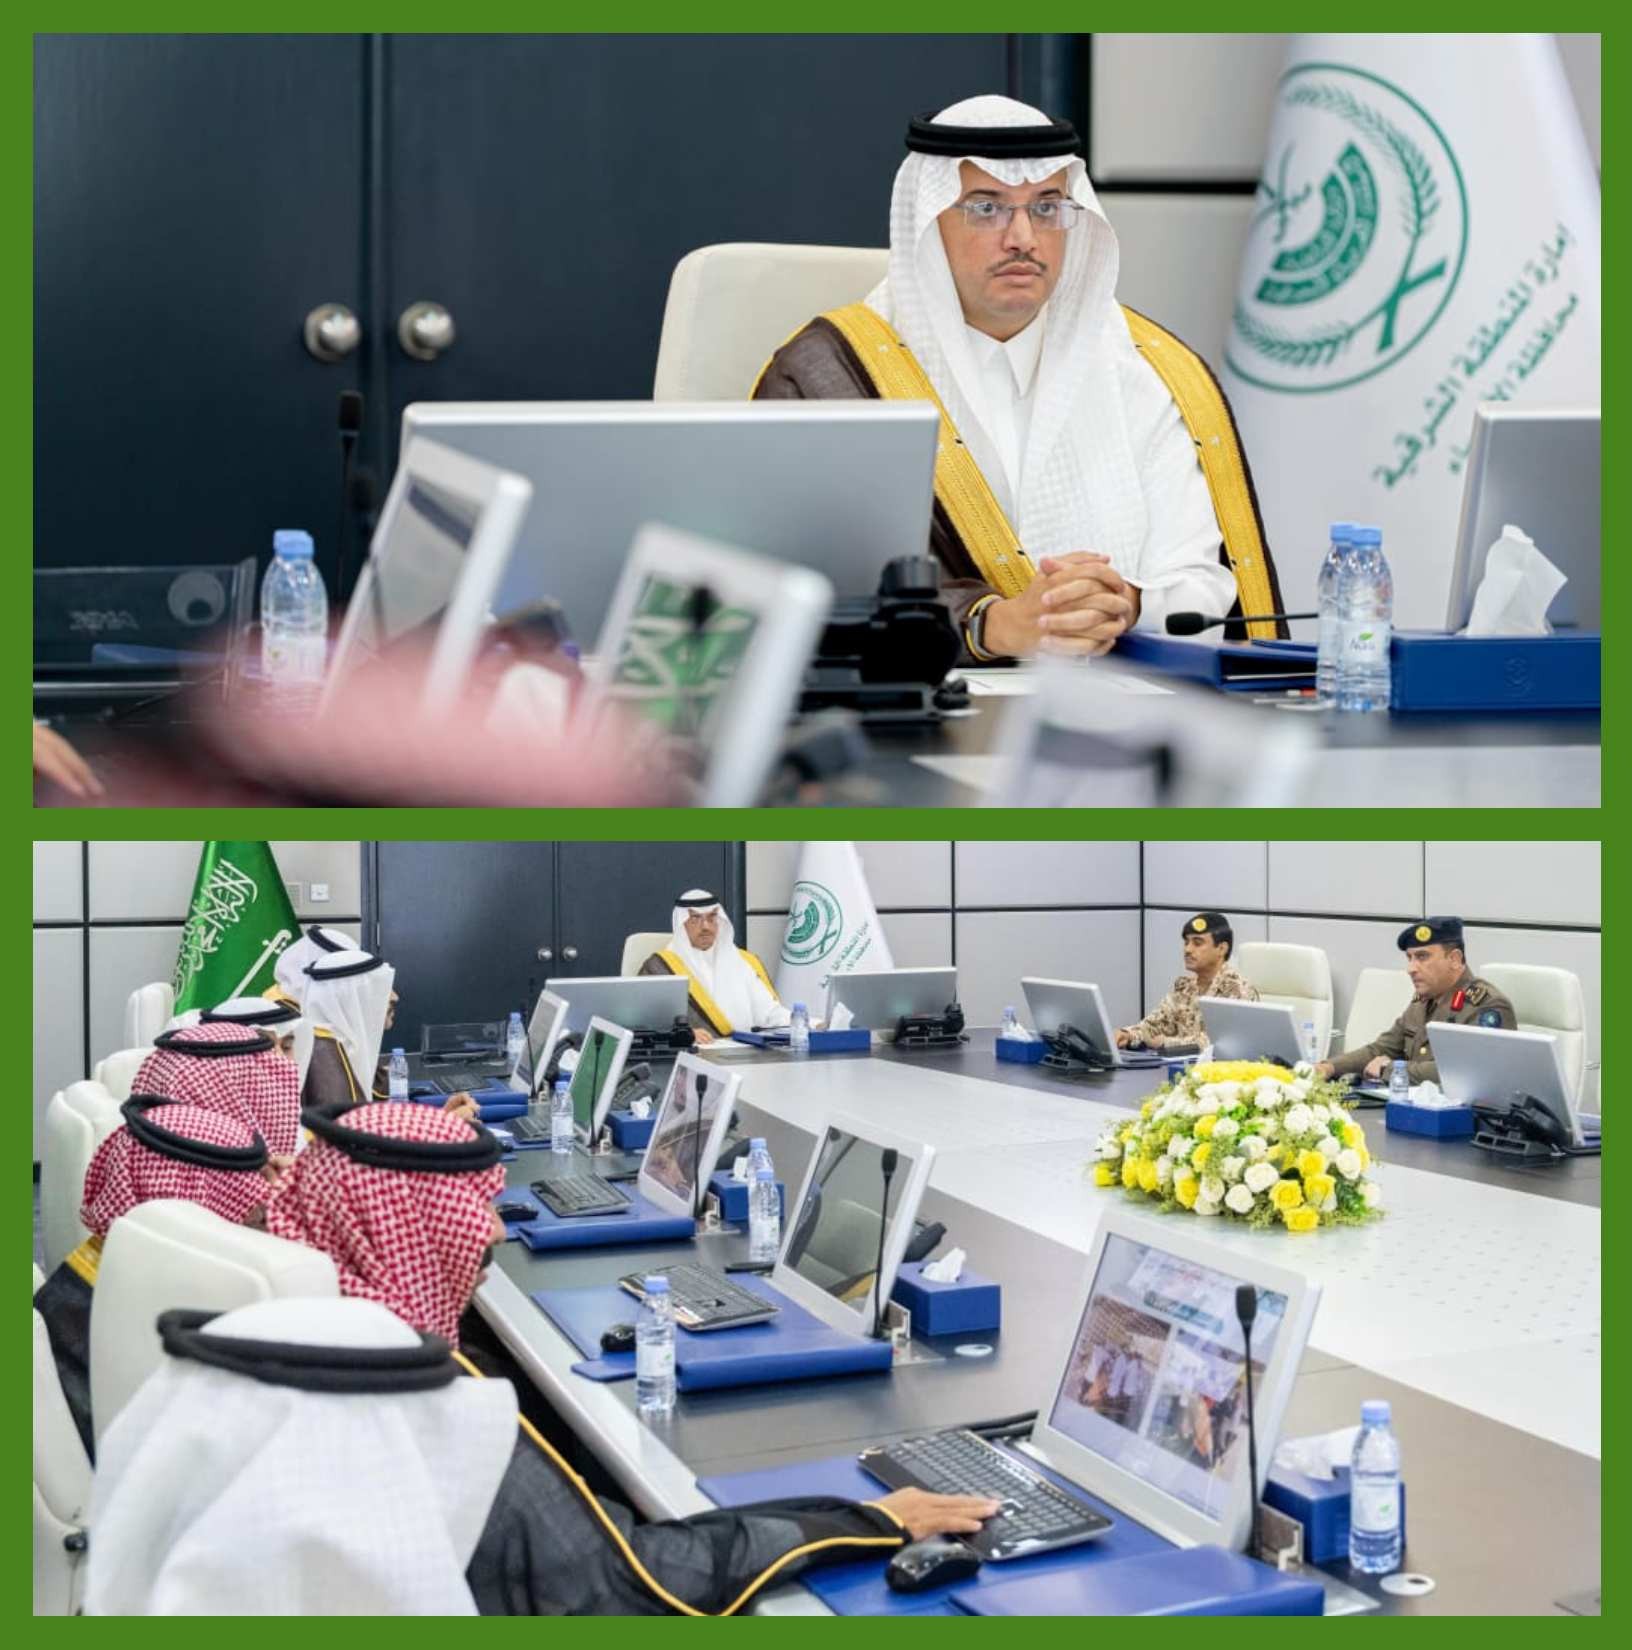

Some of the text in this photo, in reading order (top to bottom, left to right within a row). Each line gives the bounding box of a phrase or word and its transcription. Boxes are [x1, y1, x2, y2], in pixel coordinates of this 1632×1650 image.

[1452, 279, 1534, 376] المنطقة
[1507, 292, 1579, 380] محافظة
[1372, 375, 1463, 488] الشرقية
